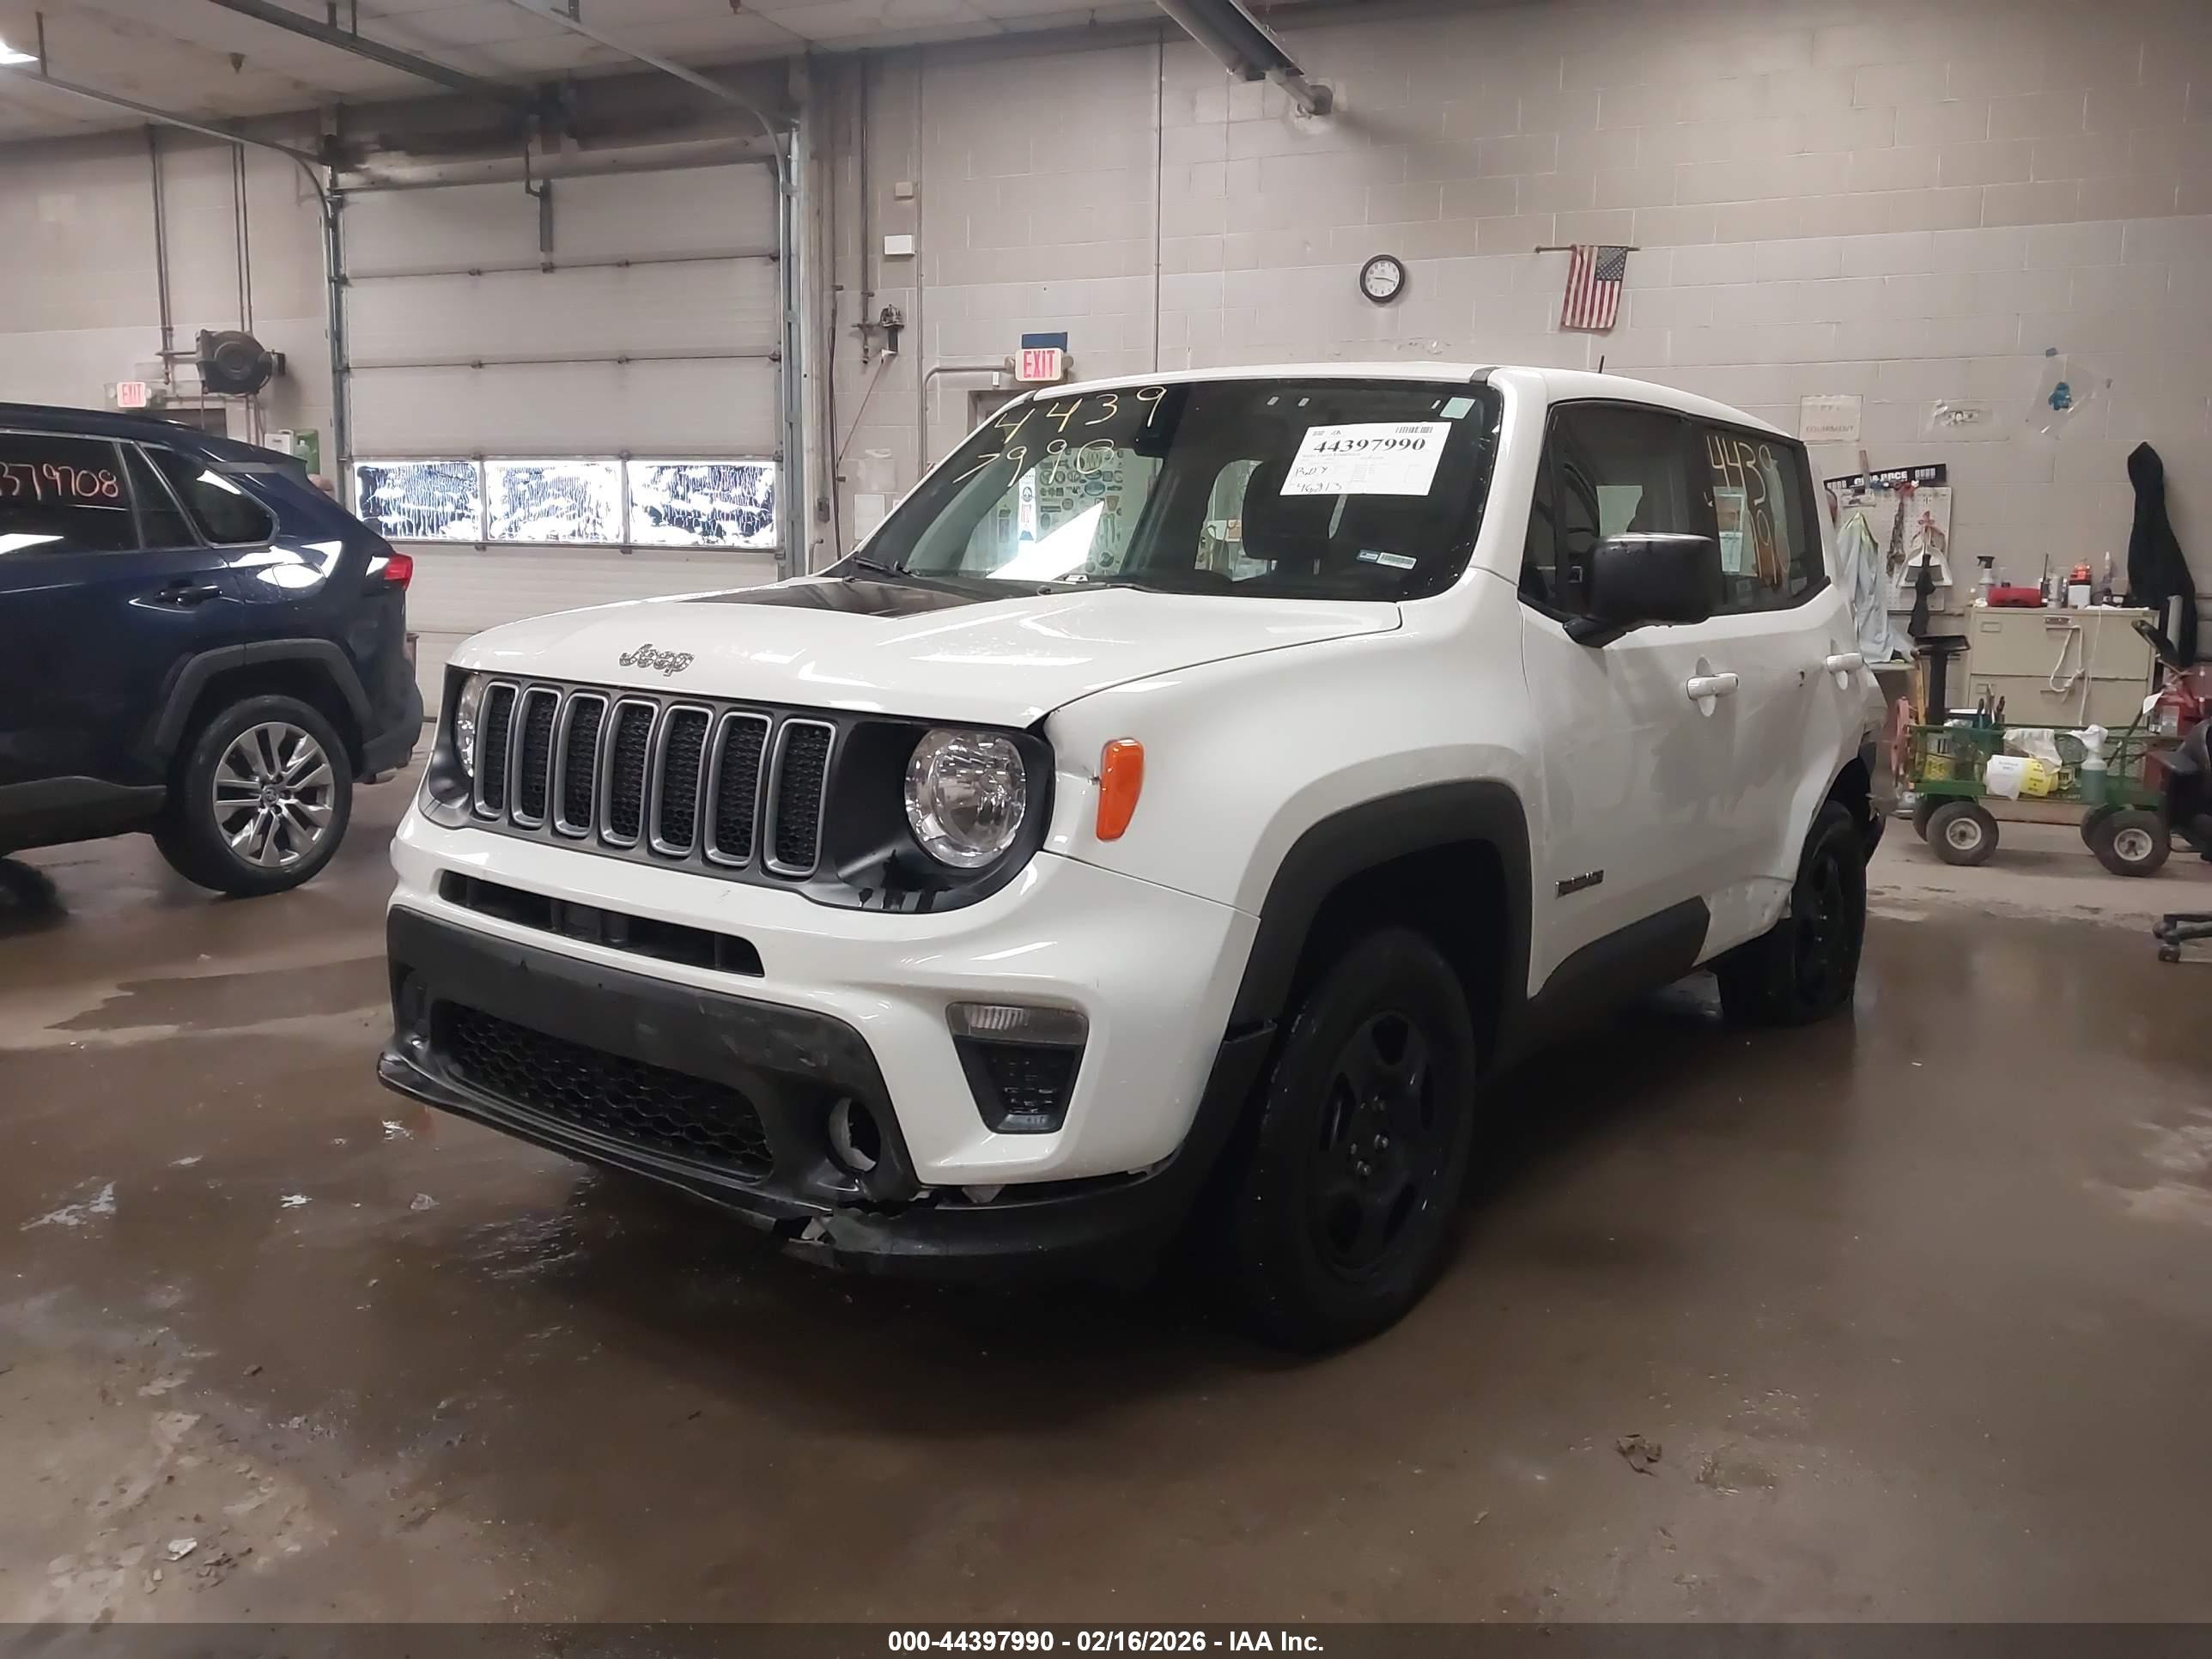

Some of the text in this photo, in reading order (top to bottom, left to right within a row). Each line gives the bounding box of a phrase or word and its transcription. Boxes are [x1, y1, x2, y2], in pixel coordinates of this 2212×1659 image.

[1023, 350, 1055, 378] EXIT
[122, 384, 142, 405] EXIT
[994, 386, 1167, 445] 4439
[1313, 438, 1426, 453] 44397990
[0, 461, 118, 501] 379708
[952, 439, 1115, 488] 7990
[619, 643, 696, 678] Jeep
